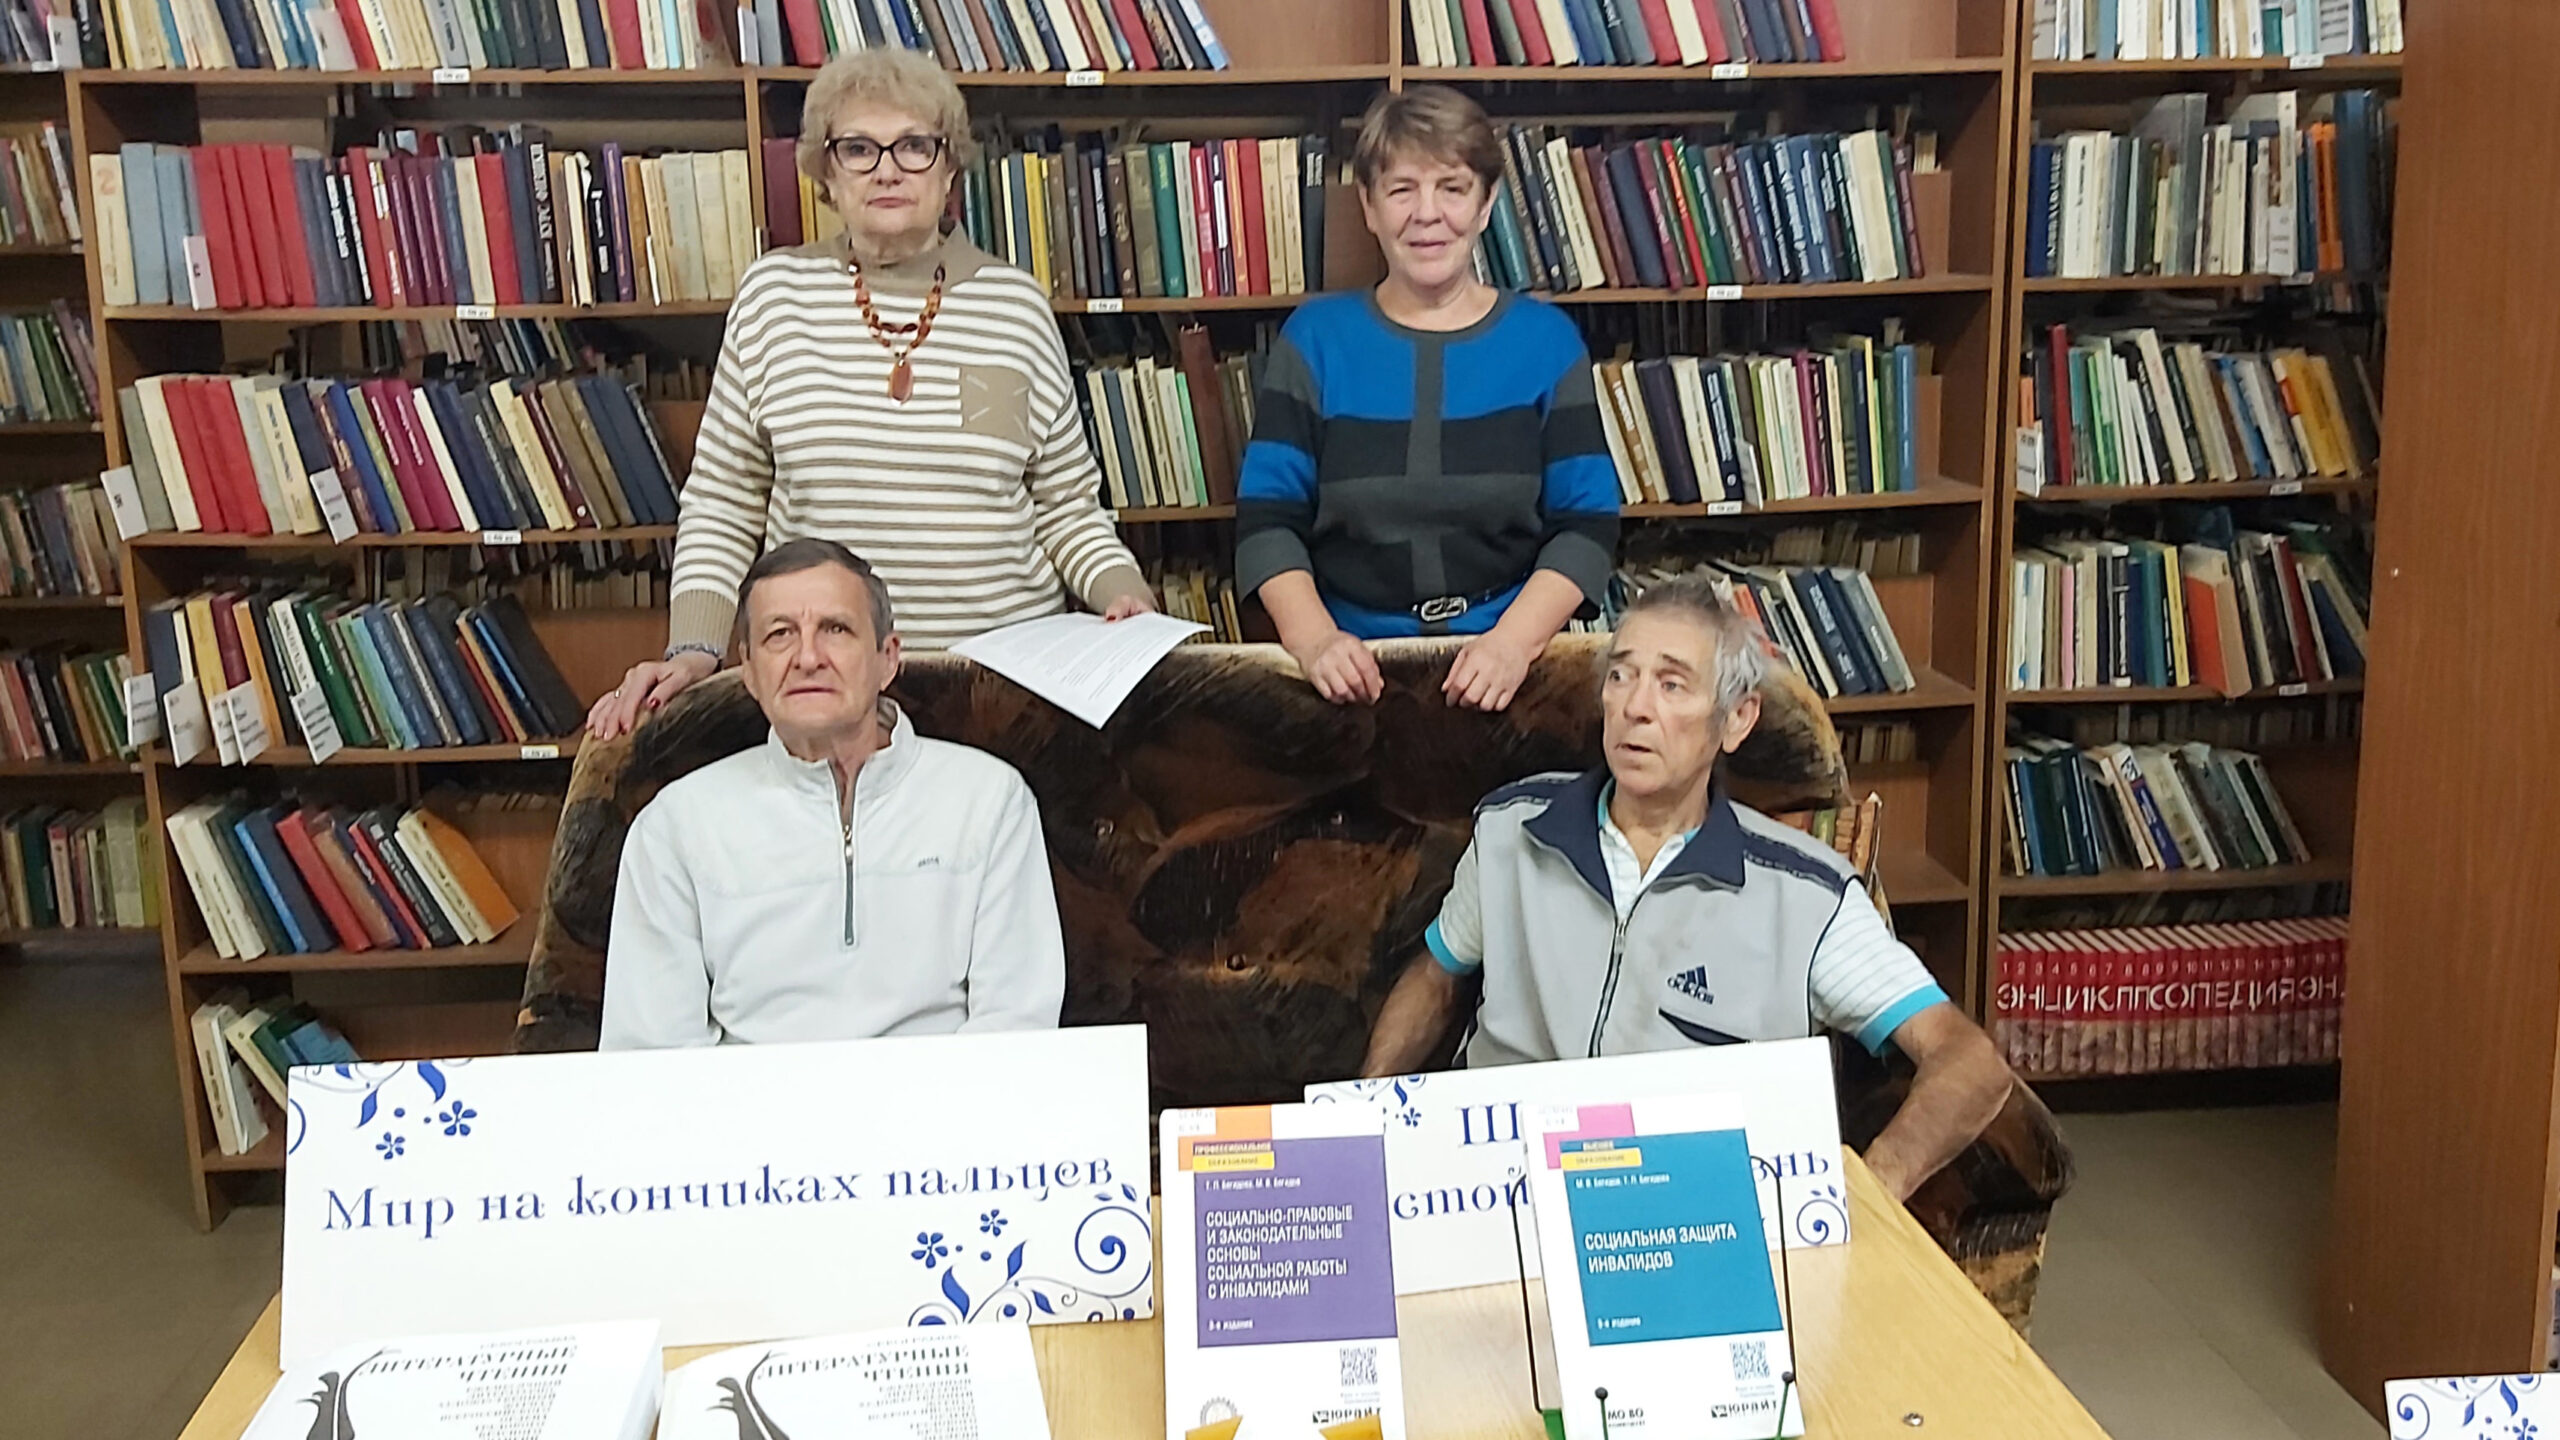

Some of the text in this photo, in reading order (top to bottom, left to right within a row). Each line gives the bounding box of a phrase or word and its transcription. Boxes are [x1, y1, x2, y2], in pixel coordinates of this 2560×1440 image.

[1457, 1102, 1522, 1145] Ш
[1393, 1152, 1829, 1220] стой знь
[323, 1157, 1115, 1240] Мир на кончиках пальцев
[1206, 1205, 1353, 1228] СОЦИАЛЬНО-ПРАВОВЫЕ
[1206, 1223, 1343, 1246] И ЗАКОНОДАТЕЛЬНЫЕ
[1584, 1223, 1737, 1251] СОЦИАЛЬНАЯ ЗАЩИТА
[1207, 1245, 1261, 1263] ОСНОВЫ
[1588, 1251, 1673, 1274] ИНВАЛИДОВ
[1207, 1258, 1347, 1282] СОЦИАЛЬНОЙ РАБОТЫ
[1208, 1279, 1309, 1300] С ИНВАЛИДАМИ
[358, 1345, 578, 1377] ЛИТЕРАТУРНЫЕ
[460, 1363, 568, 1382] ЧТЕНИЯ
[757, 1345, 970, 1380] ЛИТЕРАТУРНЫЕ
[864, 1362, 969, 1382] ЧТЕНИЯ
[1729, 1399, 1778, 1414] ЮРАЙТ
